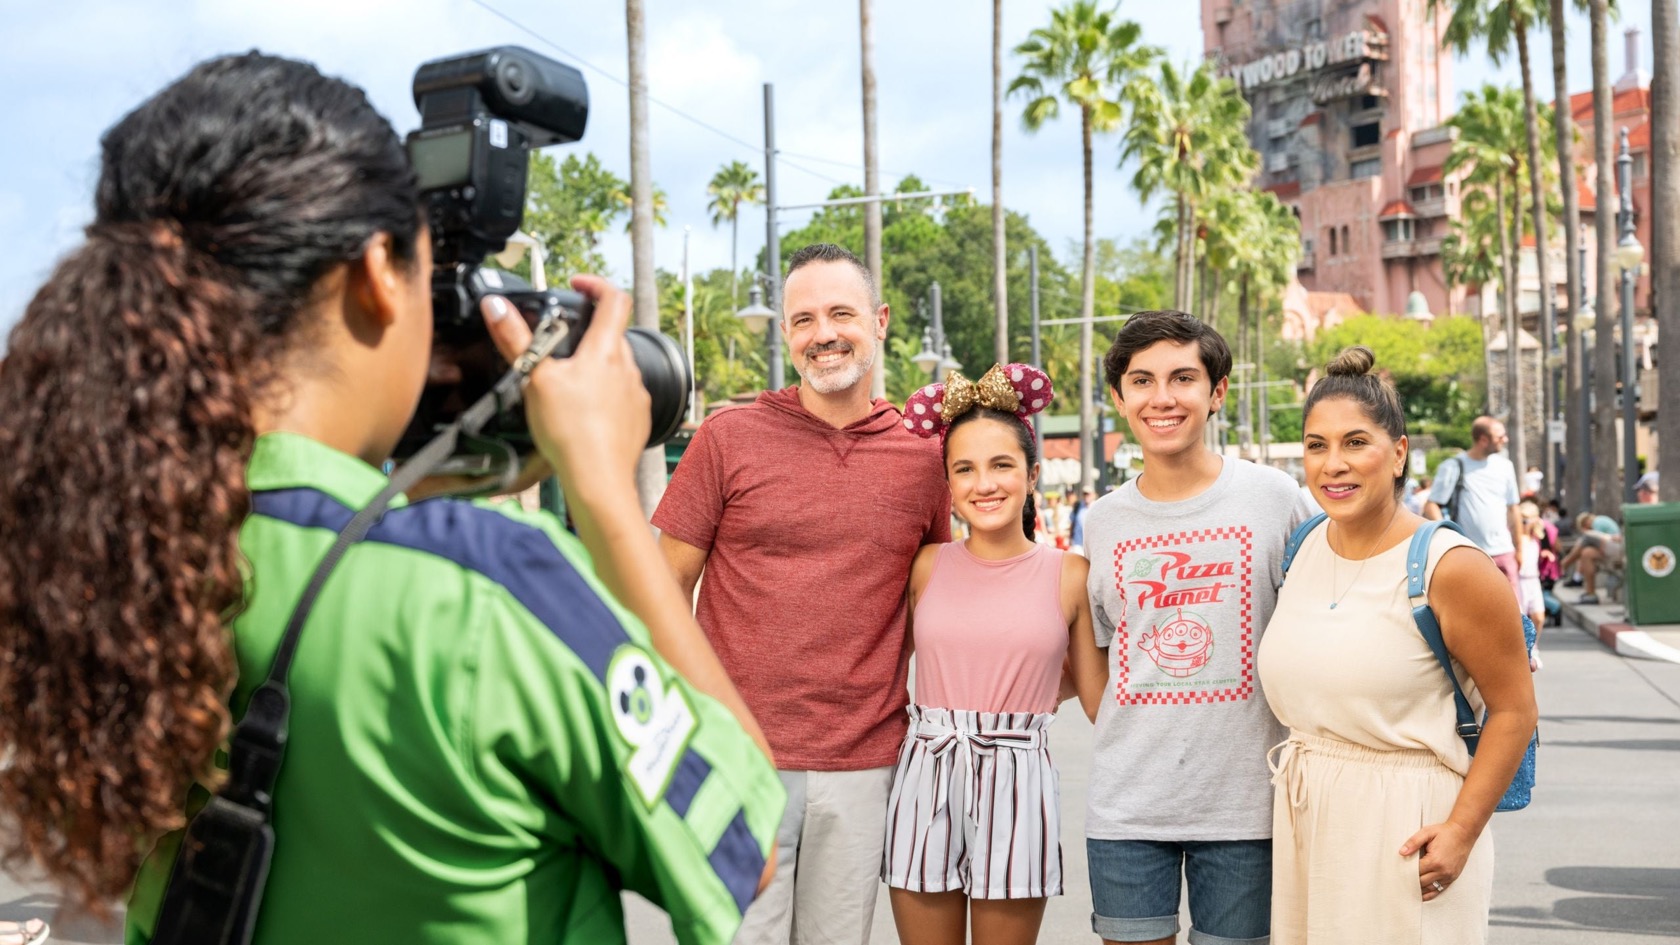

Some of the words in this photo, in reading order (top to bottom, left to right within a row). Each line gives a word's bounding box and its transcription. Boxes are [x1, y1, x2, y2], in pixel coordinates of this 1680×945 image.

[1303, 30, 1370, 71] TOWER
[1151, 551, 1235, 581] Pizza
[1127, 580, 1229, 611] Planet
